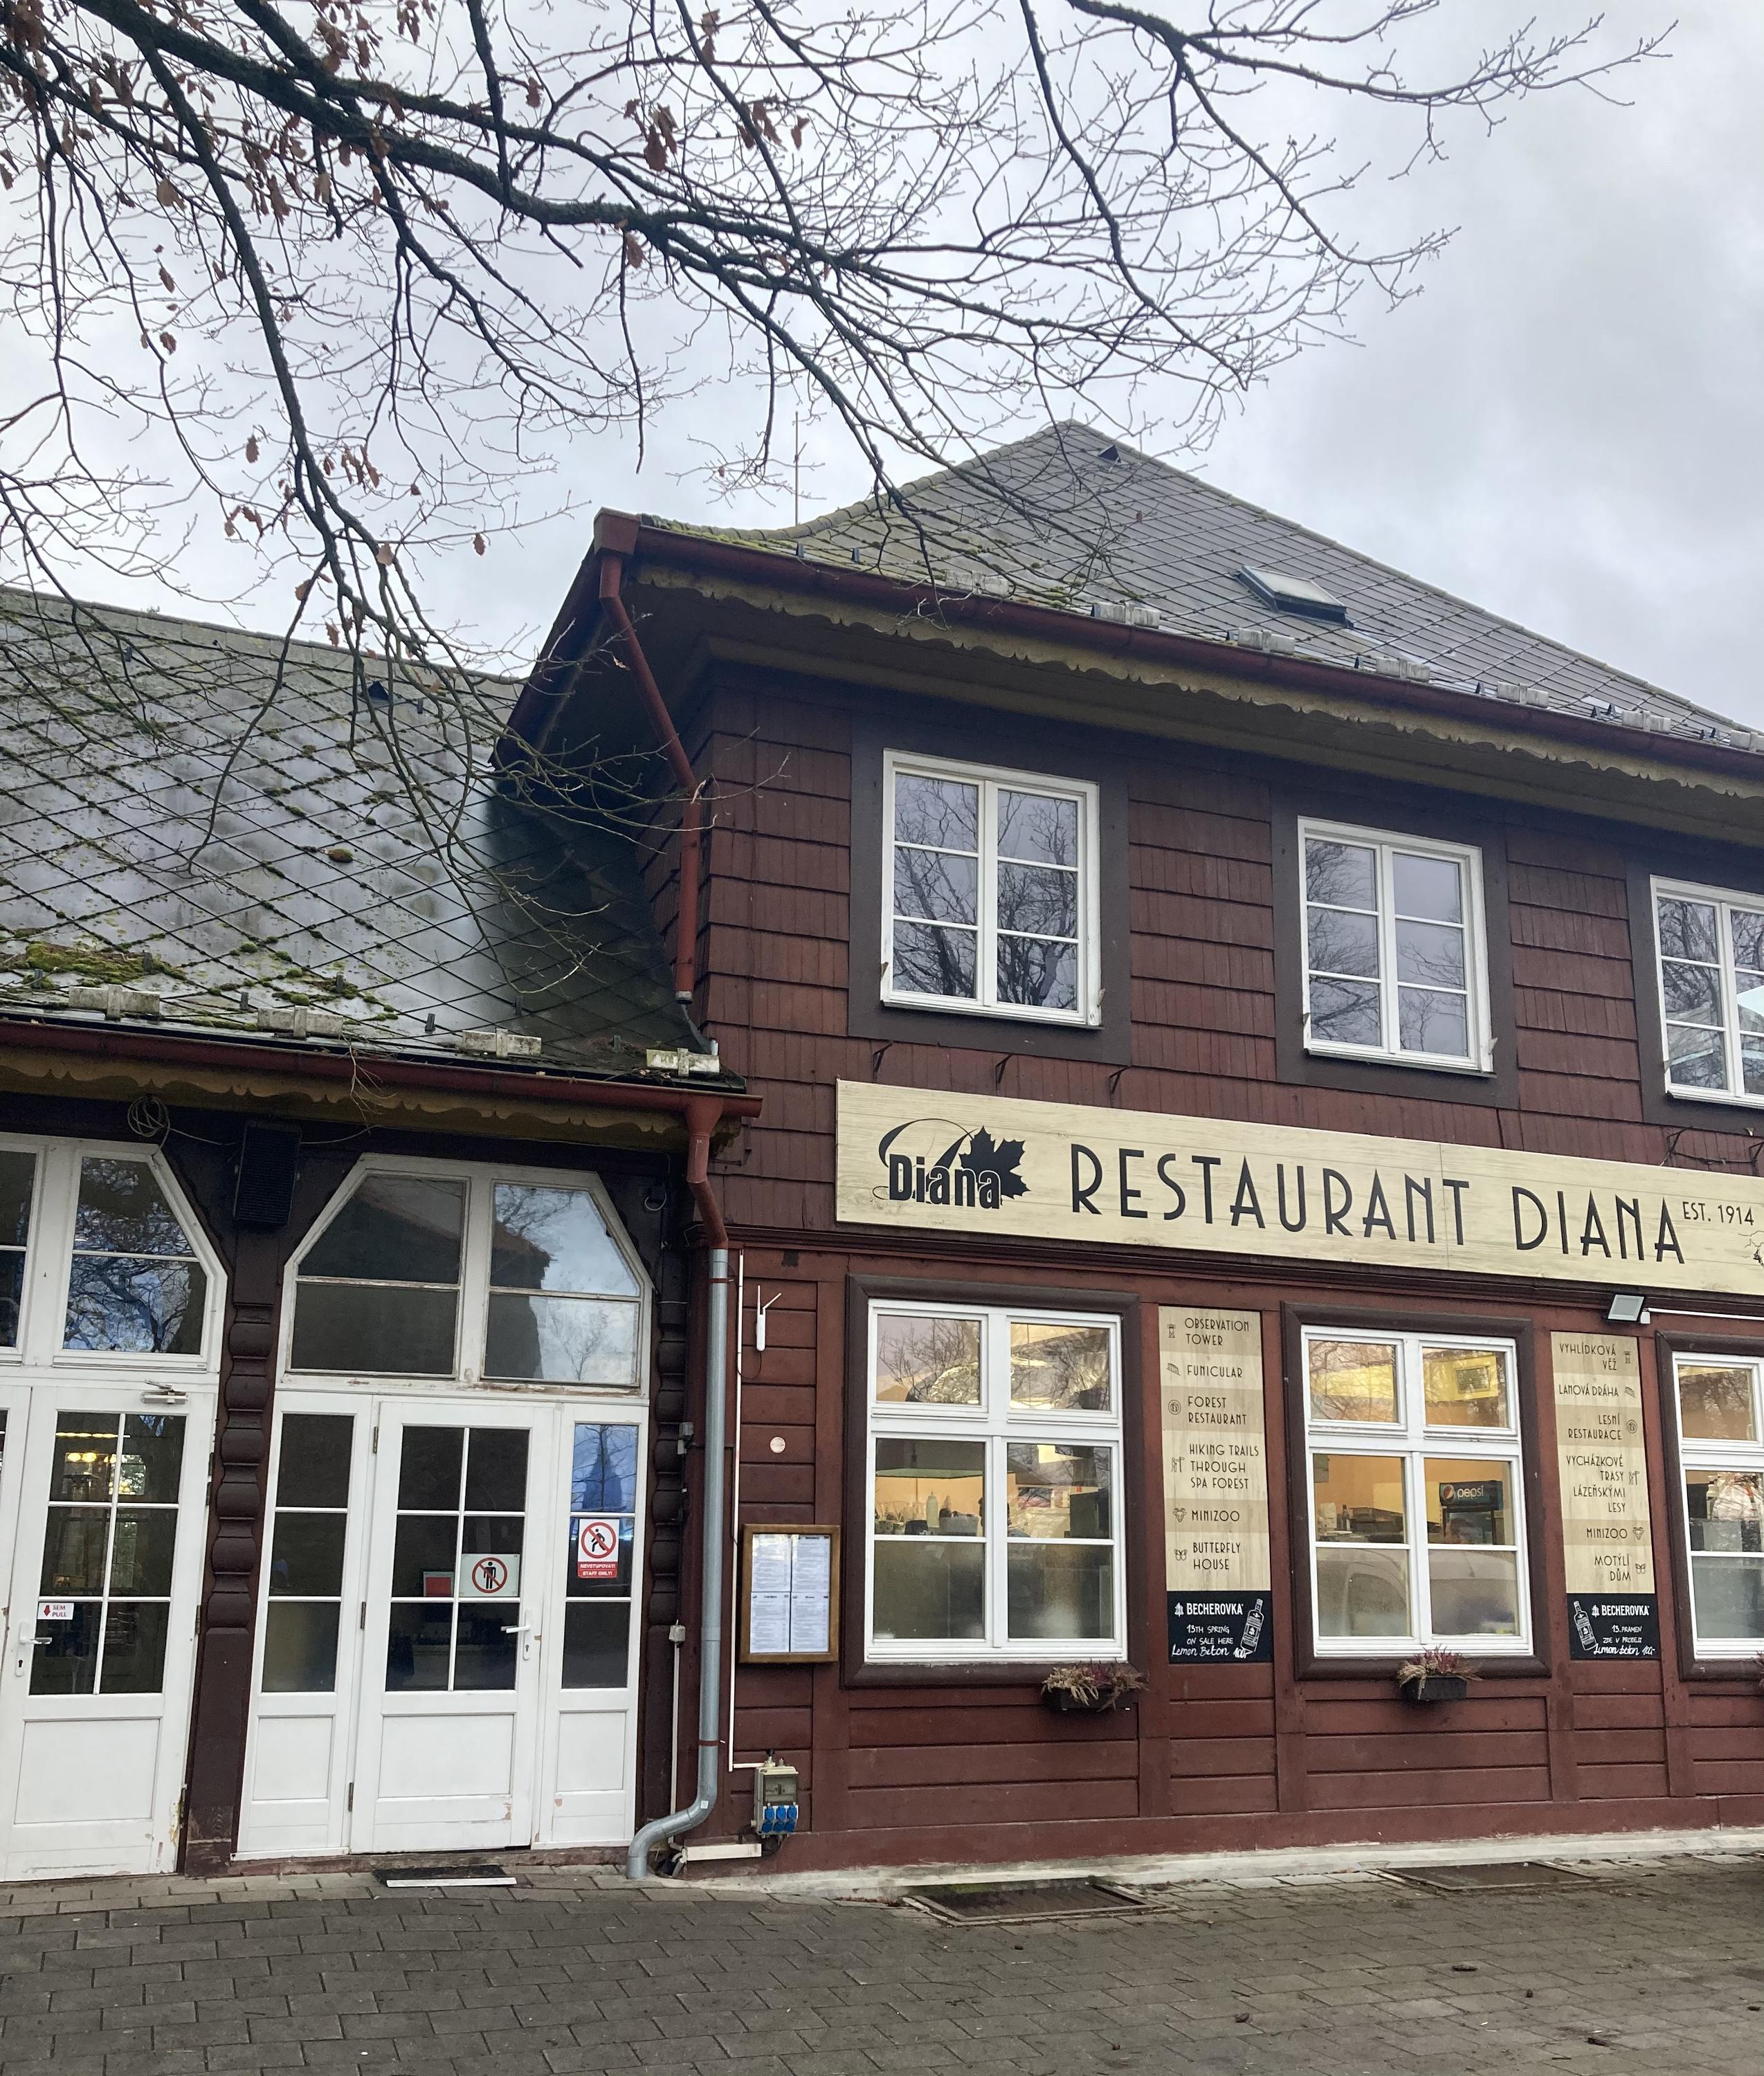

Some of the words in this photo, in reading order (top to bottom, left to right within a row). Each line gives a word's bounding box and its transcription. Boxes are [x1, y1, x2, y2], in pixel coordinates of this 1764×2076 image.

[889, 1154, 1001, 1210] Diana
[1071, 1143, 1469, 1246] RESTAURANT
[1512, 1185, 1685, 1264] DIANA
[1682, 1201, 1711, 1222] EST.
[1718, 1204, 1754, 1226] 1914
[1184, 1318, 1250, 1332] OBSERVATION
[1185, 1333, 1224, 1346] TOWER
[1559, 1342, 1616, 1356] VYHLÍDKOVÁ
[1602, 1358, 1617, 1371] VĚŽ
[1187, 1365, 1243, 1378] FUNICULAR
[1558, 1383, 1590, 1396] LANOVÁ
[1592, 1383, 1619, 1397] DRÁHA
[1188, 1396, 1227, 1408] FOREST
[1188, 1412, 1247, 1426] RESTAURANT
[1599, 1412, 1621, 1426] LESNÍ
[1568, 1428, 1622, 1440] RESTAURACE
[1190, 1444, 1225, 1455] HIKING
[1229, 1444, 1260, 1457] TRAILS
[1190, 1460, 1246, 1473] THROUGH
[1566, 1453, 1624, 1467] VYCHÁZKOVÉ
[1600, 1470, 1624, 1482] TRASY
[1190, 1477, 1208, 1488] SPA
[1212, 1477, 1249, 1489] FOREST
[1457, 1484, 1484, 1500] pepsi
[1573, 1484, 1626, 1498] LÁZEŇSKÝMI
[1608, 1502, 1626, 1513] LESY
[1192, 1510, 1240, 1522] MINIZOO
[1586, 1528, 1628, 1539] MINIZOO
[1192, 1542, 1241, 1554] BUTTERFLY
[1193, 1558, 1230, 1570] HOUSE
[1594, 1553, 1630, 1567] MOTÝLÍ
[1610, 1568, 1631, 1581] DŮM
[1186, 1603, 1244, 1615] BECHEROVKA
[1601, 1605, 1649, 1616] BECHEROVKA
[1186, 1624, 1204, 1634] 13TH
[1207, 1626, 1230, 1634] SPRING
[1172, 1643, 1198, 1657] Lemon
